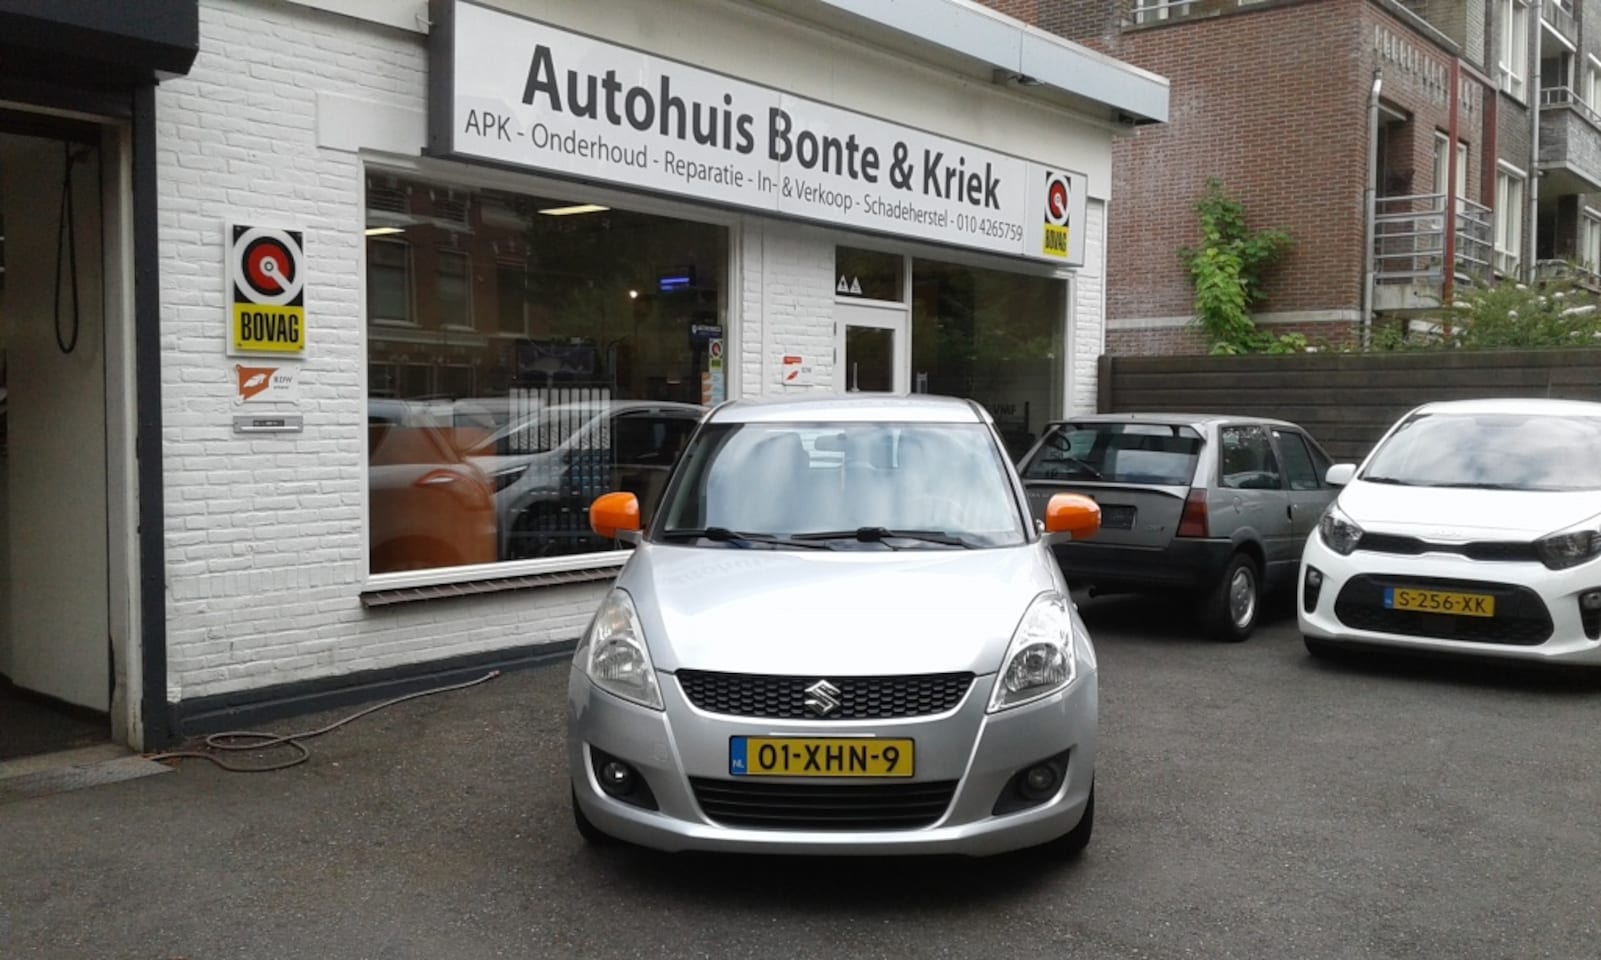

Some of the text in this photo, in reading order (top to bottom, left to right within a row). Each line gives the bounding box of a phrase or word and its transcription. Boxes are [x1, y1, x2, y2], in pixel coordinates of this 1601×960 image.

[521, 44, 1001, 210] Autohuis Bonte & Kriek
[465, 109, 511, 142] APK
[531, 122, 648, 168] Onderhoud
[664, 151, 744, 187] Reparatie
[782, 177, 793, 198] &
[795, 180, 853, 214] Verkoop
[864, 193, 948, 228] Schadeherstel
[956, 214, 976, 233] 010
[978, 217, 1023, 242] 4265759
[241, 312, 299, 343] BOVAG
[1398, 591, 1487, 614] S-256-XK
[732, 760, 744, 768] NL
[758, 744, 900, 772] 01-XHN-9
